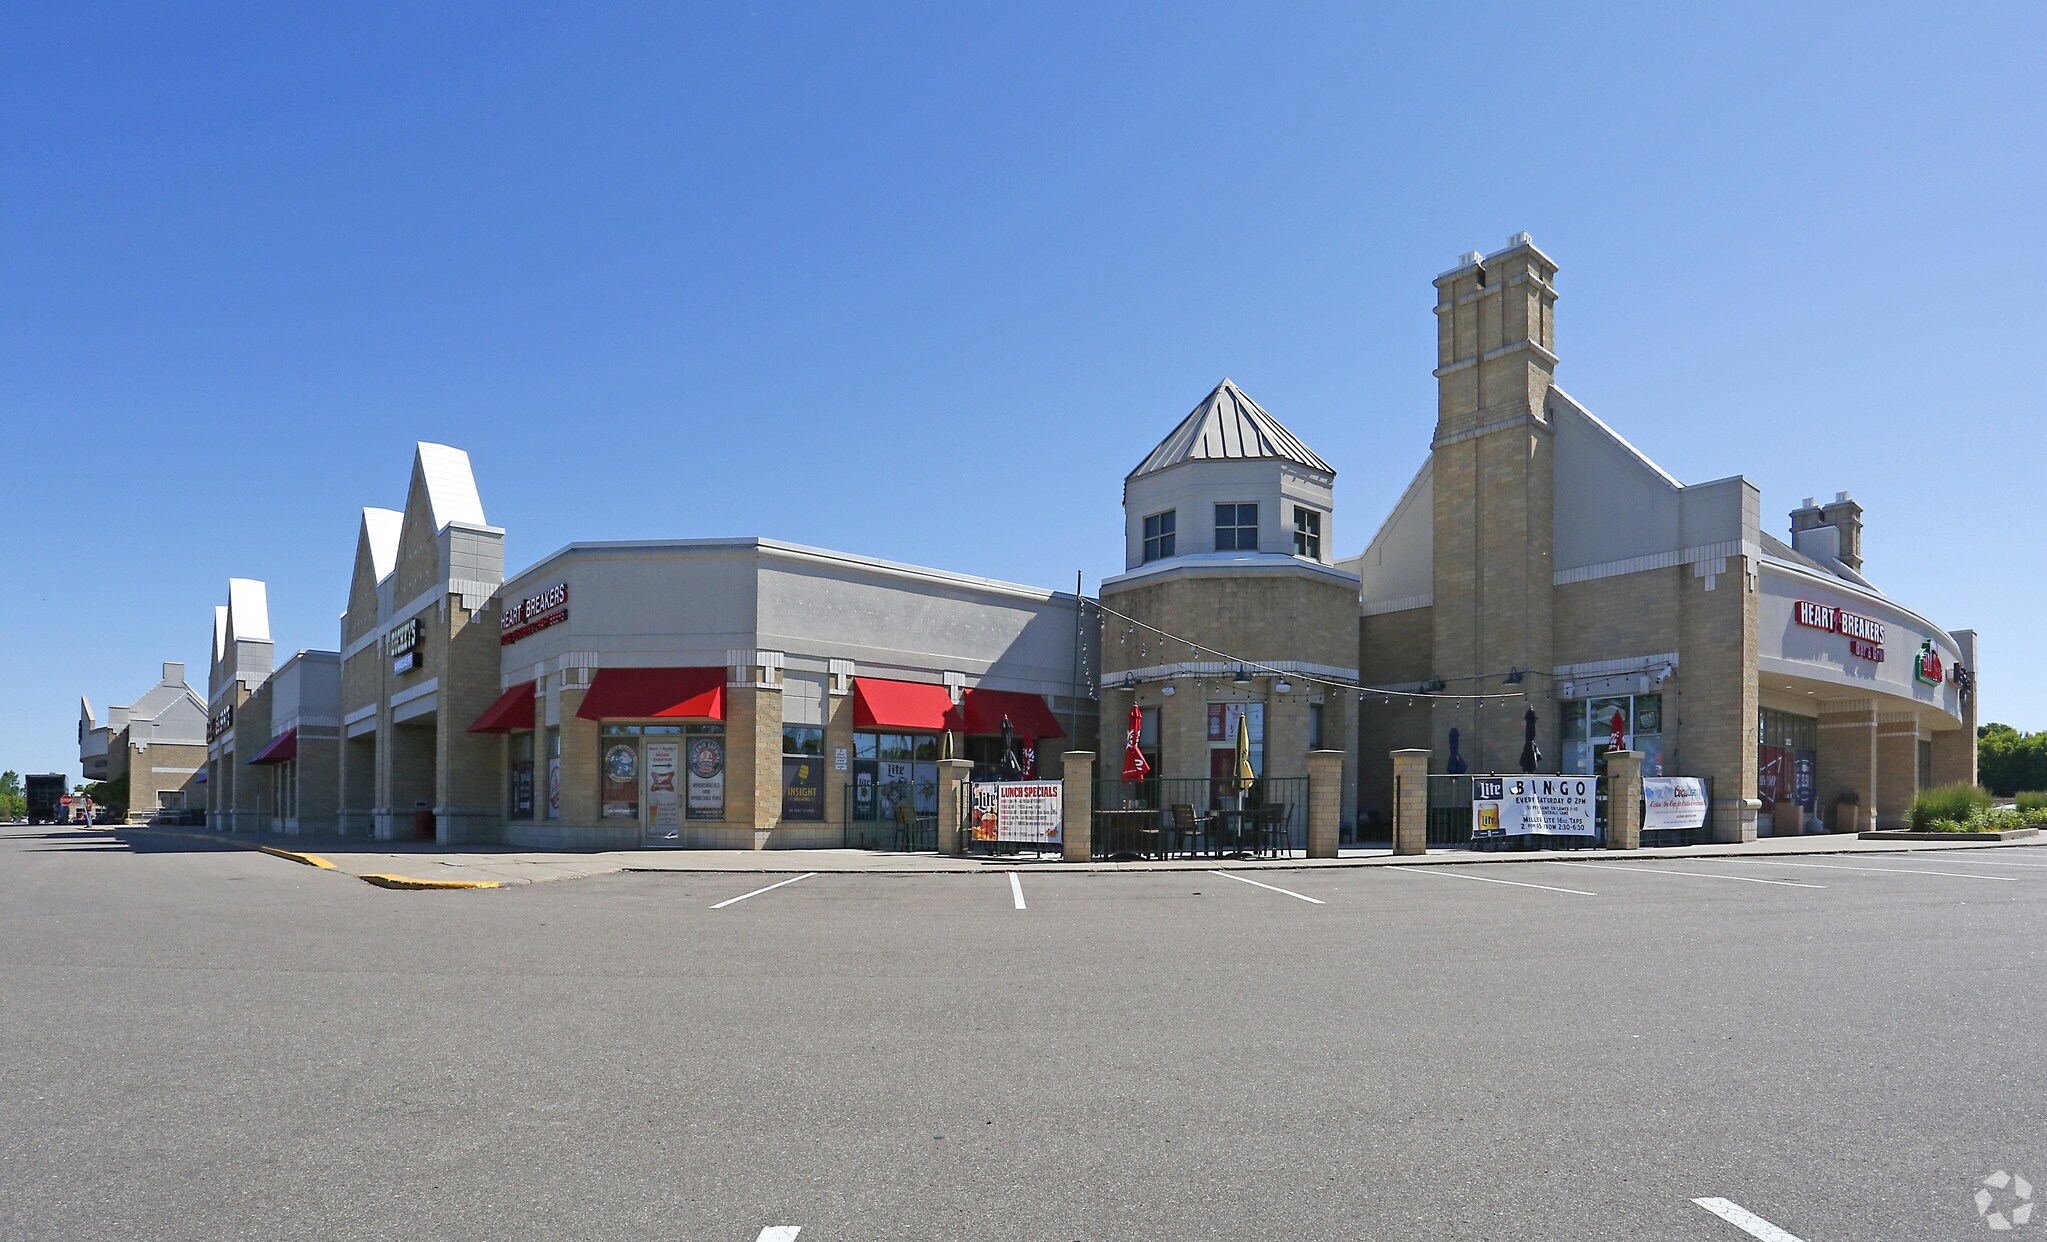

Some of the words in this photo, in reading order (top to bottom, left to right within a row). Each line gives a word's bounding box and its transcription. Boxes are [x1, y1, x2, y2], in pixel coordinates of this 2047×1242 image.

[501, 604, 522, 629] HEART
[525, 583, 565, 618] BREAKERS
[1800, 601, 1834, 630] HEART
[1841, 612, 1885, 644] BREAKERS
[888, 763, 905, 778] Lite
[787, 787, 817, 797] INSIGHT
[1001, 787, 1023, 798] LUNCH
[1024, 786, 1058, 798] SPECIALS
[1479, 782, 1501, 799] Lite
[1516, 780, 1586, 796] BINGO
[978, 791, 996, 811] Lite
[1537, 796, 1565, 804] SATURDAY
[1481, 815, 1496, 828] Lite
